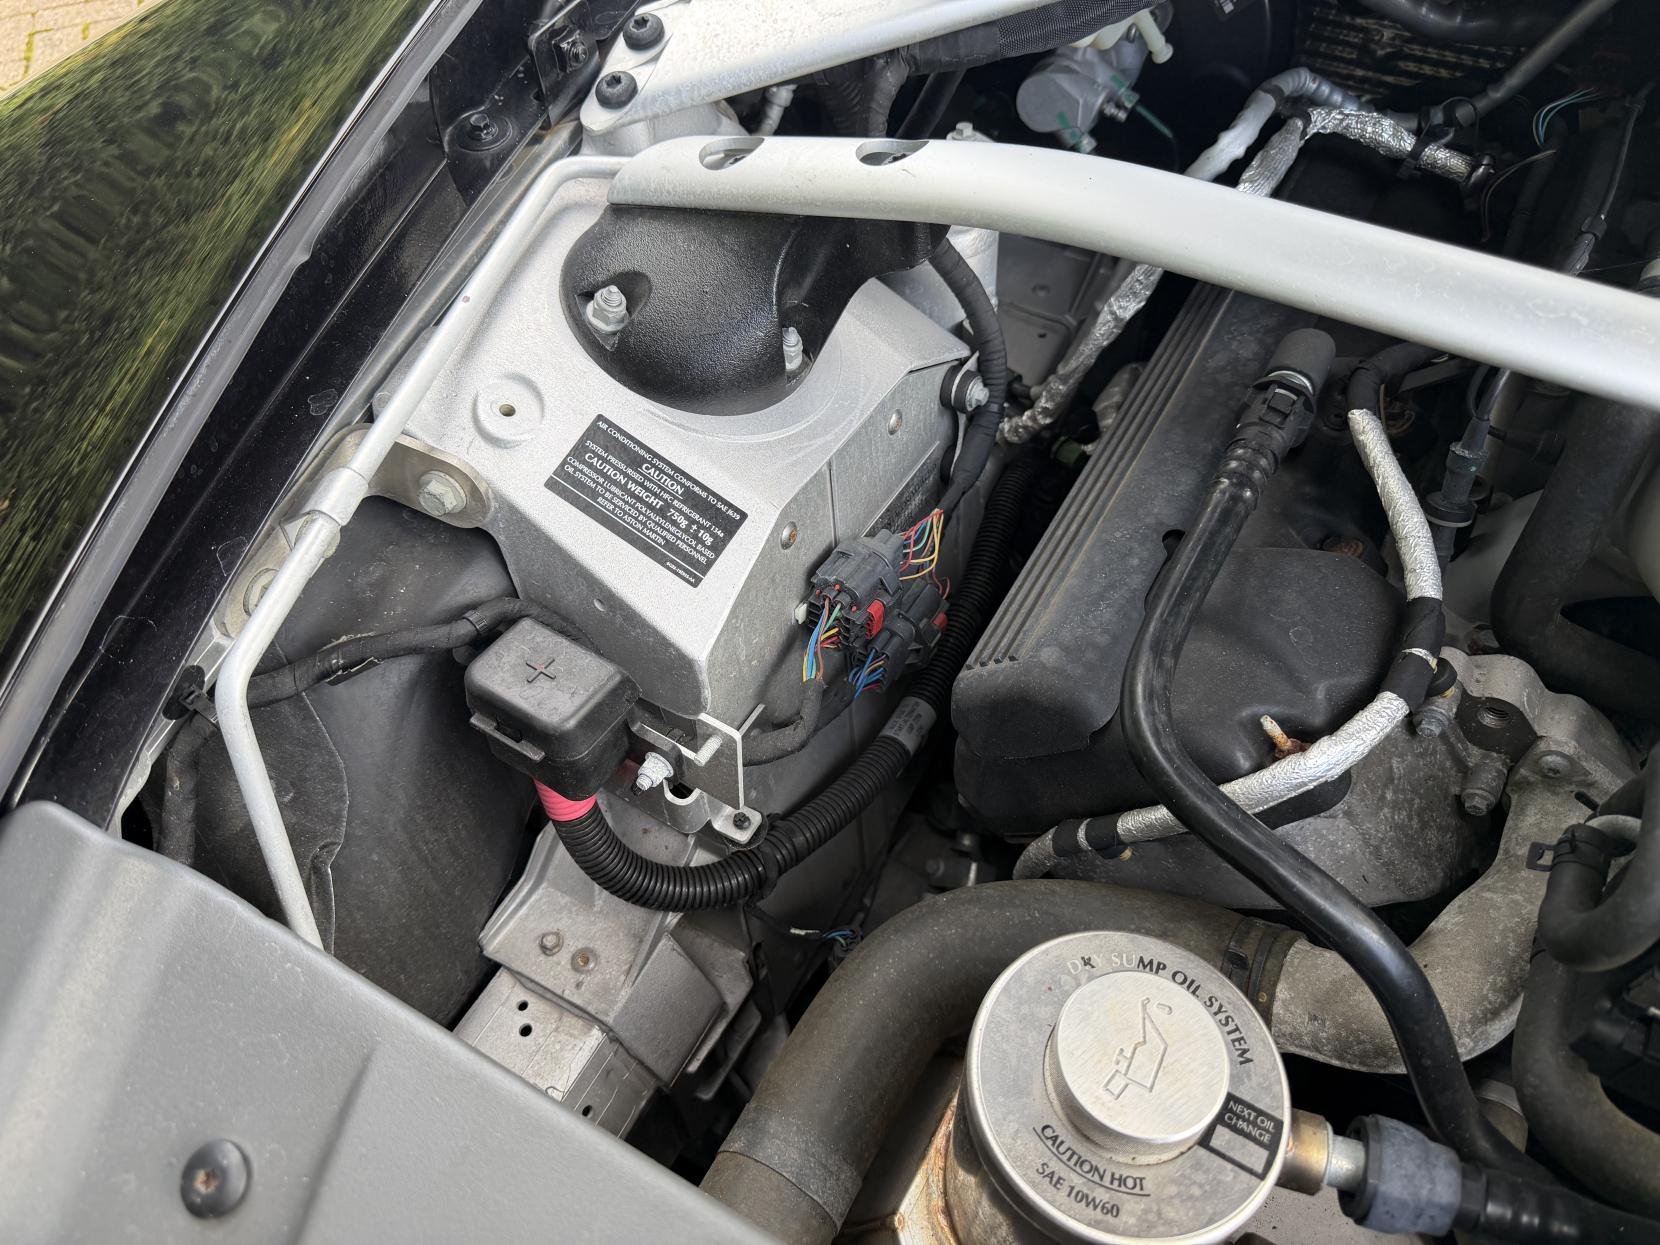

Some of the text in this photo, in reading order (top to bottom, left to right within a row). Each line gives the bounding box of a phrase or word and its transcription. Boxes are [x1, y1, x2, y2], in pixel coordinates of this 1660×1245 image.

[566, 456, 715, 558] COMPRESSOR LUBRICANT POLYALKYLENEGLYCOL BASED
[584, 440, 608, 458] SYSTEM
[606, 454, 644, 482] PRESSURISED
[643, 479, 661, 494] WITH
[659, 490, 674, 502] HFC
[671, 499, 711, 527] REFRIGERANT
[584, 452, 627, 484] CAUTION
[626, 480, 664, 508] WEIGHT
[666, 508, 688, 528] 750g
[697, 529, 713, 545] 10g
[596, 420, 740, 519] AIR CONDITIONING SYSTEM CONFORMS TO SAE J639
[641, 463, 684, 494] CAUTION
[563, 464, 707, 564] OIL SYSTEM TO BE SERVICED BY QUALIFIED PERSONNEL
[596, 496, 665, 545] REFER TO ASTON MARTIN
[1111, 952, 1167, 975] SUMP
[1171, 970, 1201, 999] OIL
[1203, 994, 1254, 1067] SYSTEM
[1223, 1112, 1273, 1144] CHANGE
[1227, 1100, 1276, 1133] NEXT OIL
[1035, 1162, 1120, 1219] SAE 10W60
[1040, 1124, 1147, 1192] CAUTION HOT
